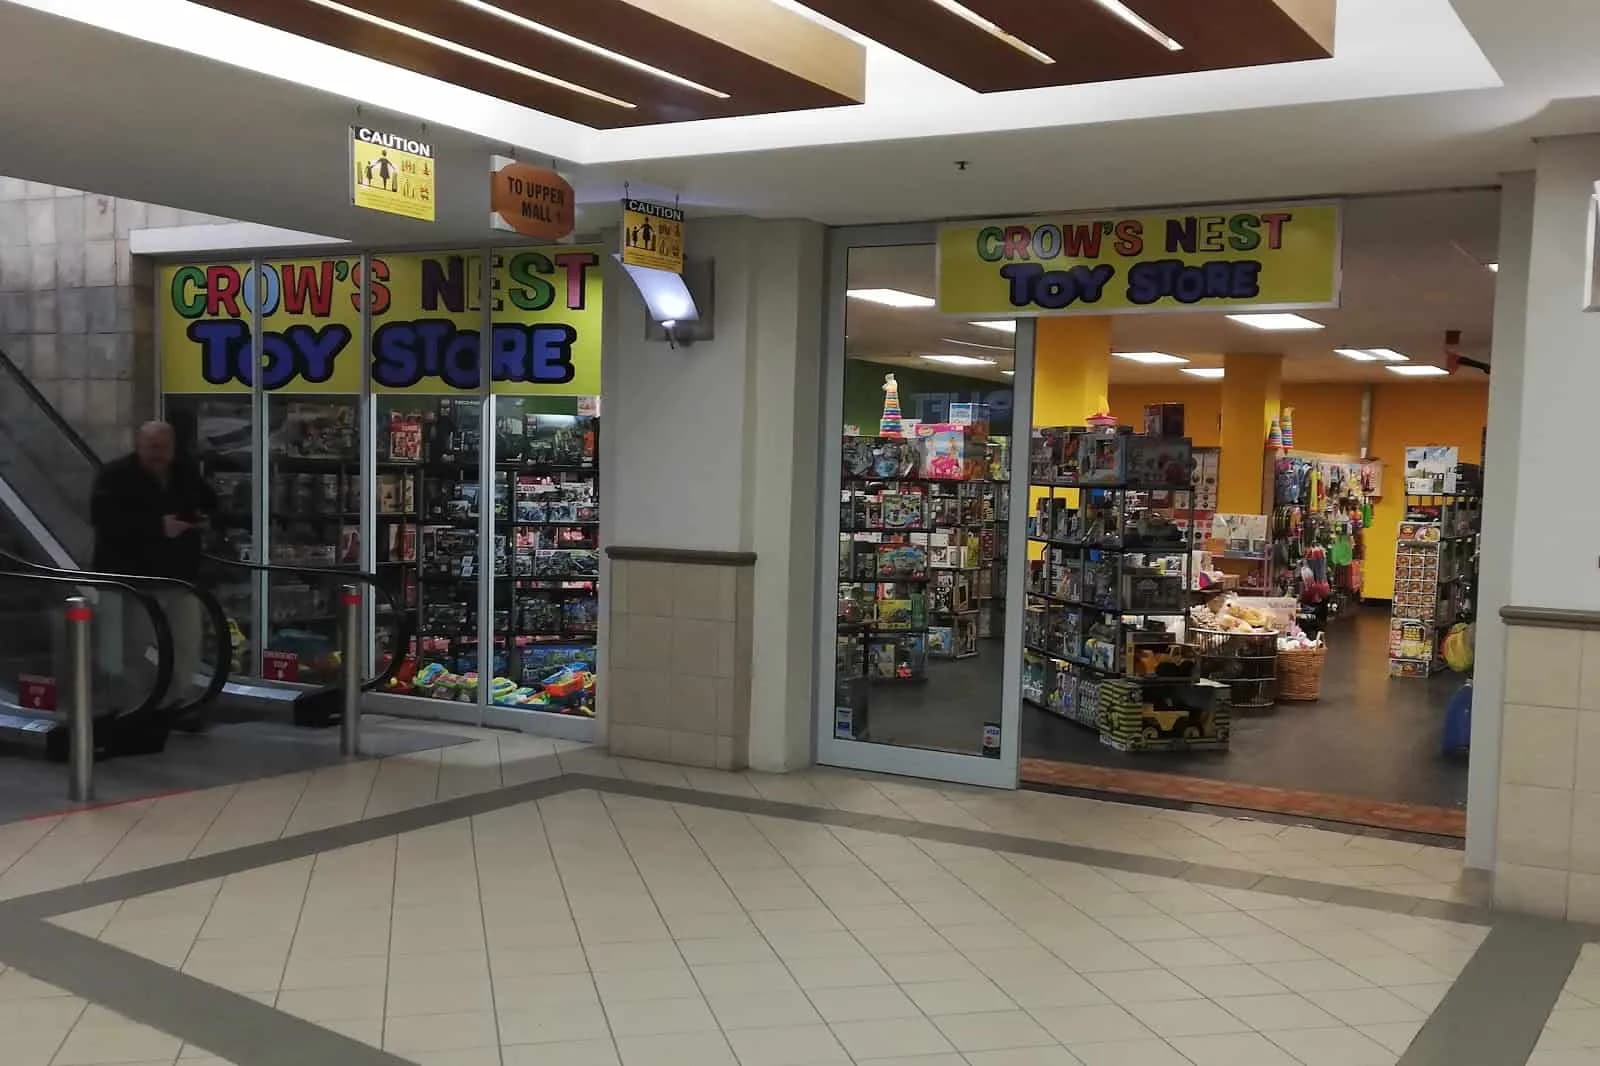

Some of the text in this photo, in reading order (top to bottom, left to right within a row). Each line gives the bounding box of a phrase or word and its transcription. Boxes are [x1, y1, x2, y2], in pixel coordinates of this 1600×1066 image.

[358, 127, 431, 157] CAUTION
[507, 176, 565, 206] TO UPPER
[628, 200, 682, 220] CAUTION
[521, 203, 553, 223] MALL
[977, 212, 1293, 262] CROW'S NEST
[171, 252, 600, 319] CROW'S NEST
[1000, 260, 1263, 308] TOY STORE
[187, 319, 577, 390] TOY STORE
